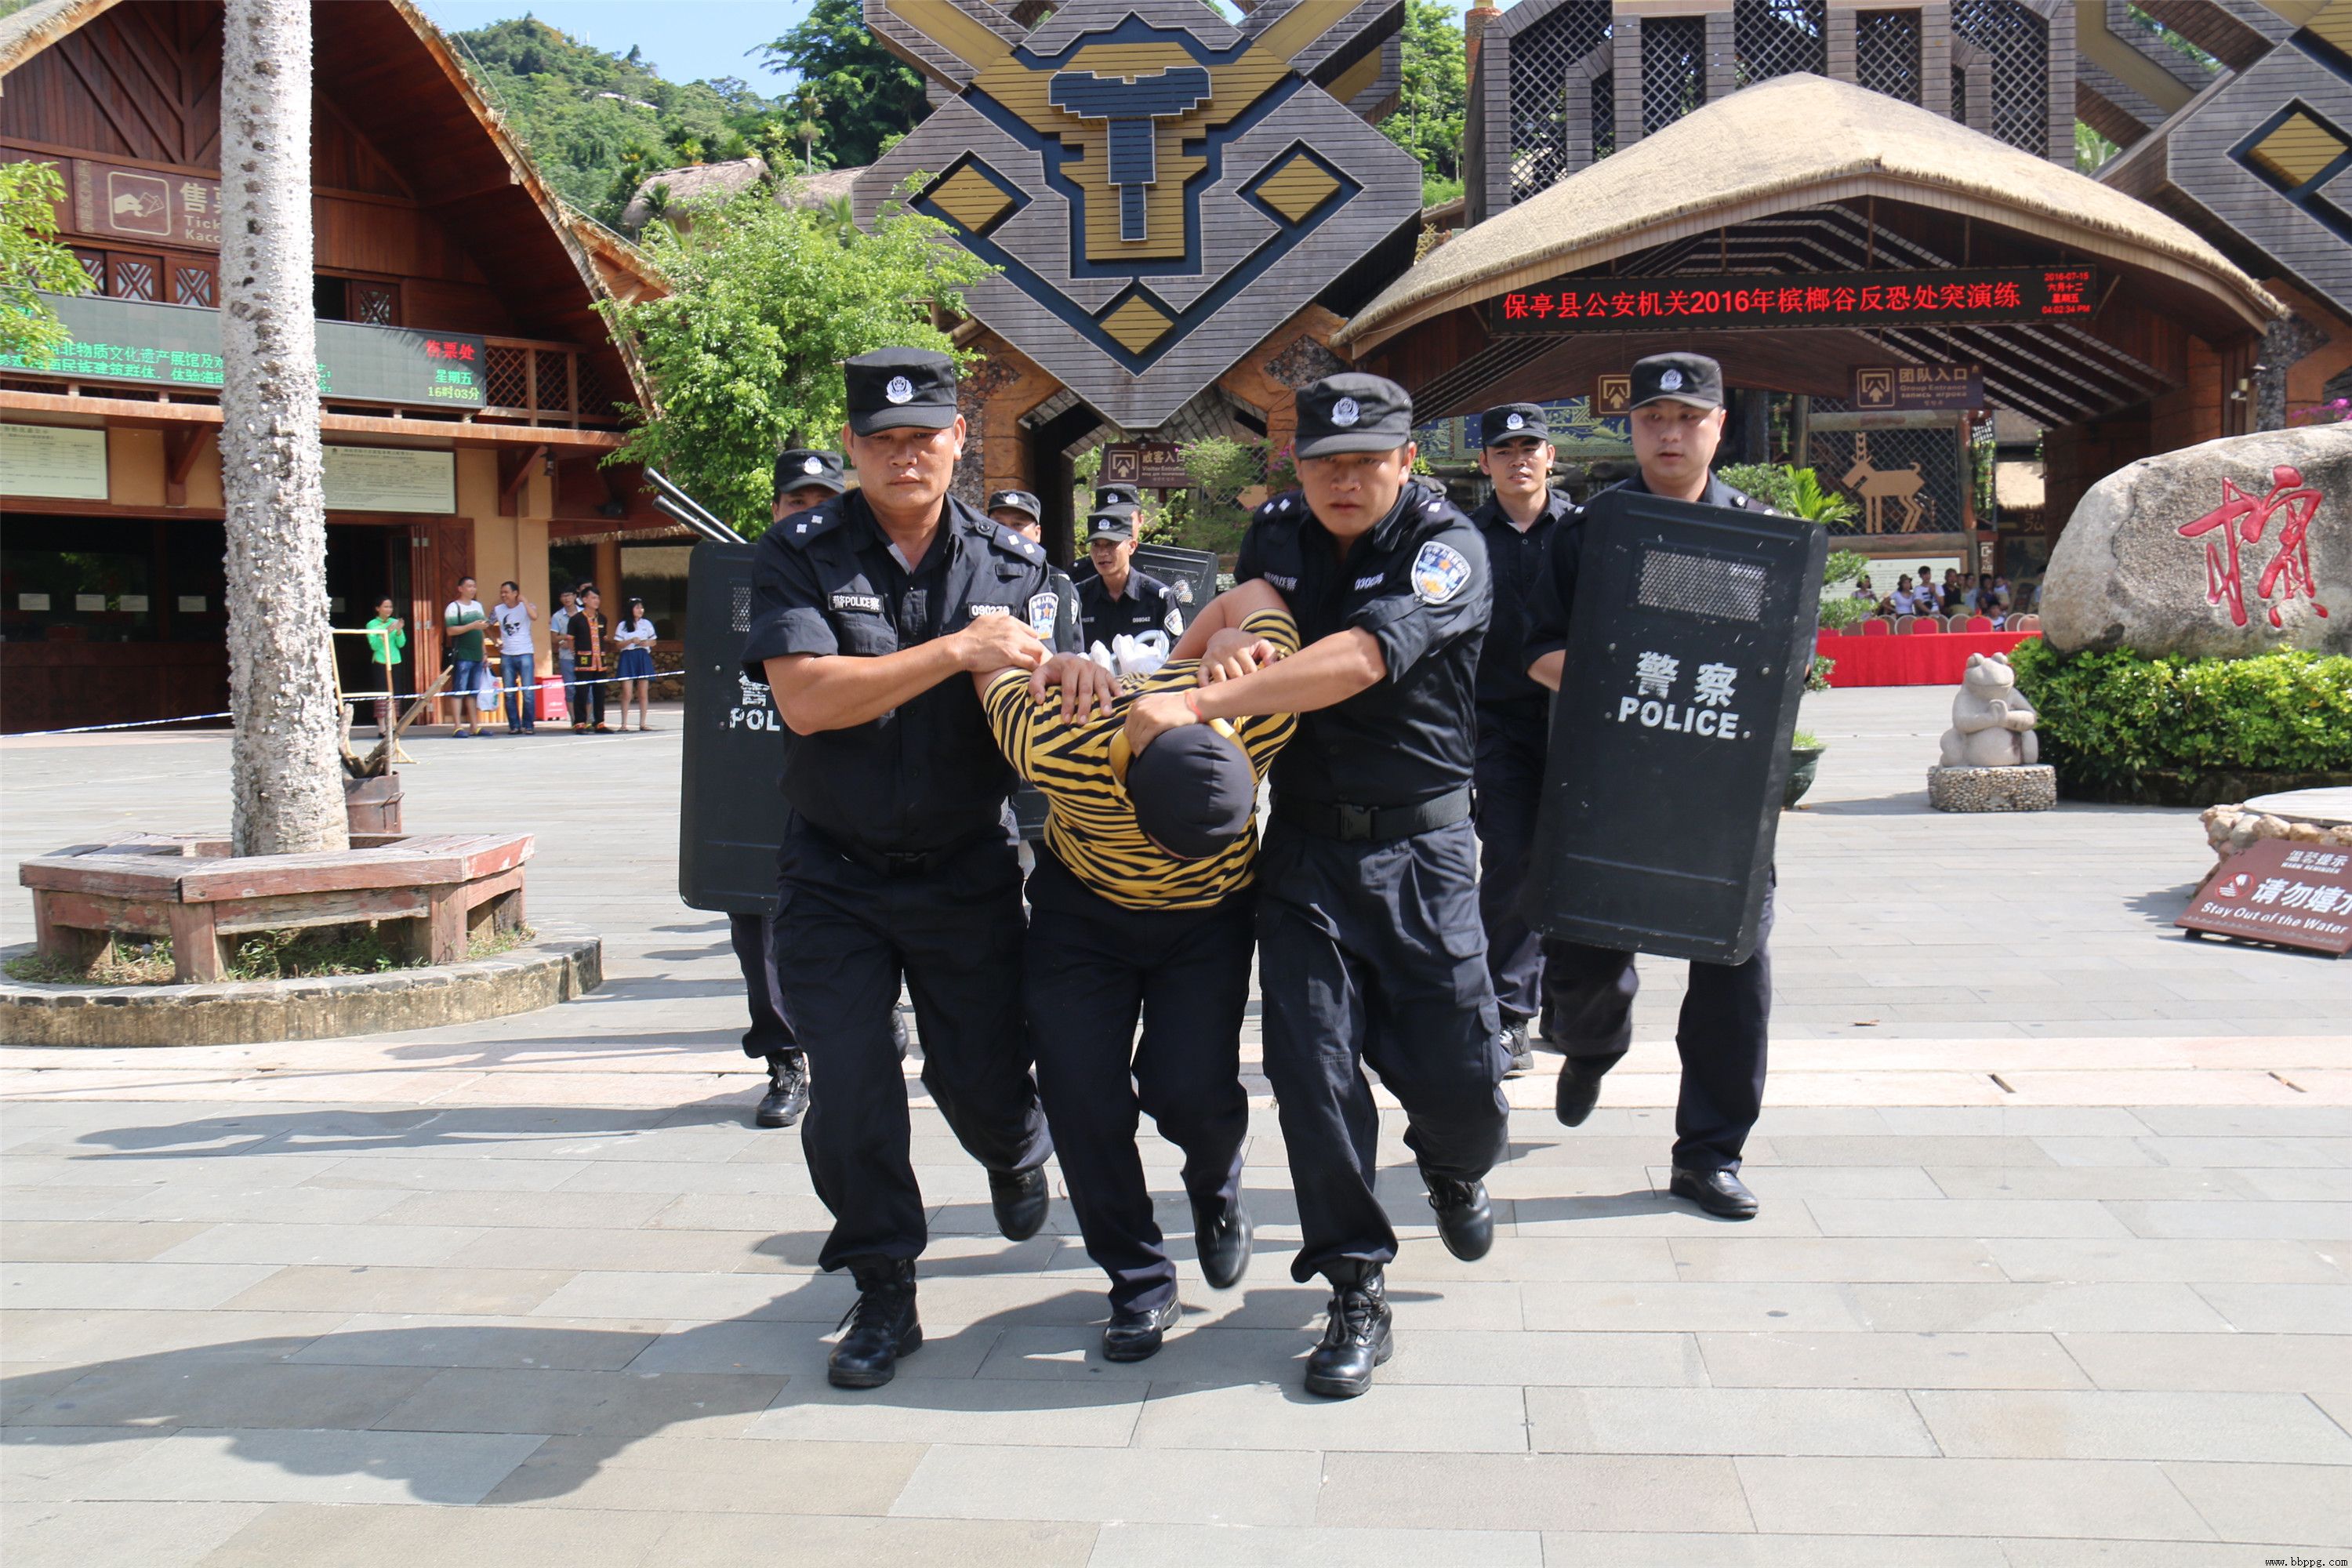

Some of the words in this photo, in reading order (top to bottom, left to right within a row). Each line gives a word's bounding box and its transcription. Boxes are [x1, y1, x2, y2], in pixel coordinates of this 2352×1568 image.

[180, 181, 221, 215] 售
[1503, 281, 2020, 320] 保亭县公安机关2016年槟榔谷反恐处突演练
[434, 368, 473, 386] 星期五
[1899, 368, 1968, 383] 团队入口
[427, 385, 480, 401] 16时03分
[729, 707, 781, 731] POL
[1617, 696, 1740, 740] POLICE
[2201, 902, 2233, 917] Stay
[2234, 907, 2261, 921] Out
[2260, 912, 2279, 923] of
[2277, 914, 2301, 927] the
[2303, 917, 2349, 935] Water
